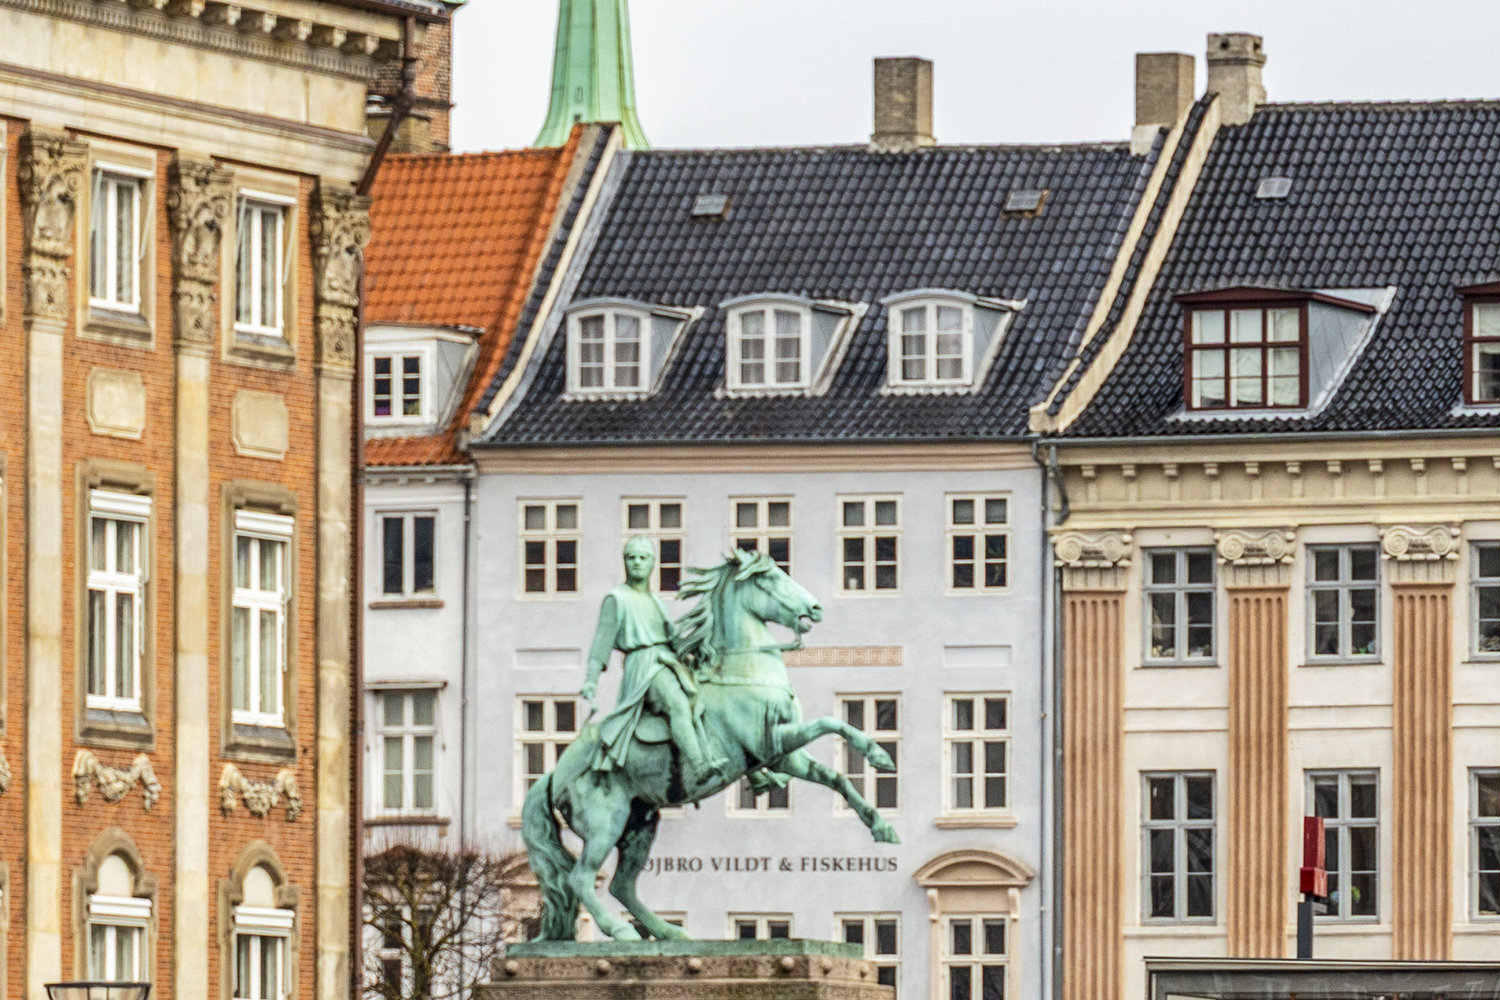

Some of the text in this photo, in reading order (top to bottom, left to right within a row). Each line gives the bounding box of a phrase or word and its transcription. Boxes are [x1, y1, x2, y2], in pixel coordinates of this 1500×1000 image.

[711, 857, 771, 872] VILDT
[779, 857, 794, 872] &
[801, 857, 898, 872] FISKEHUS
